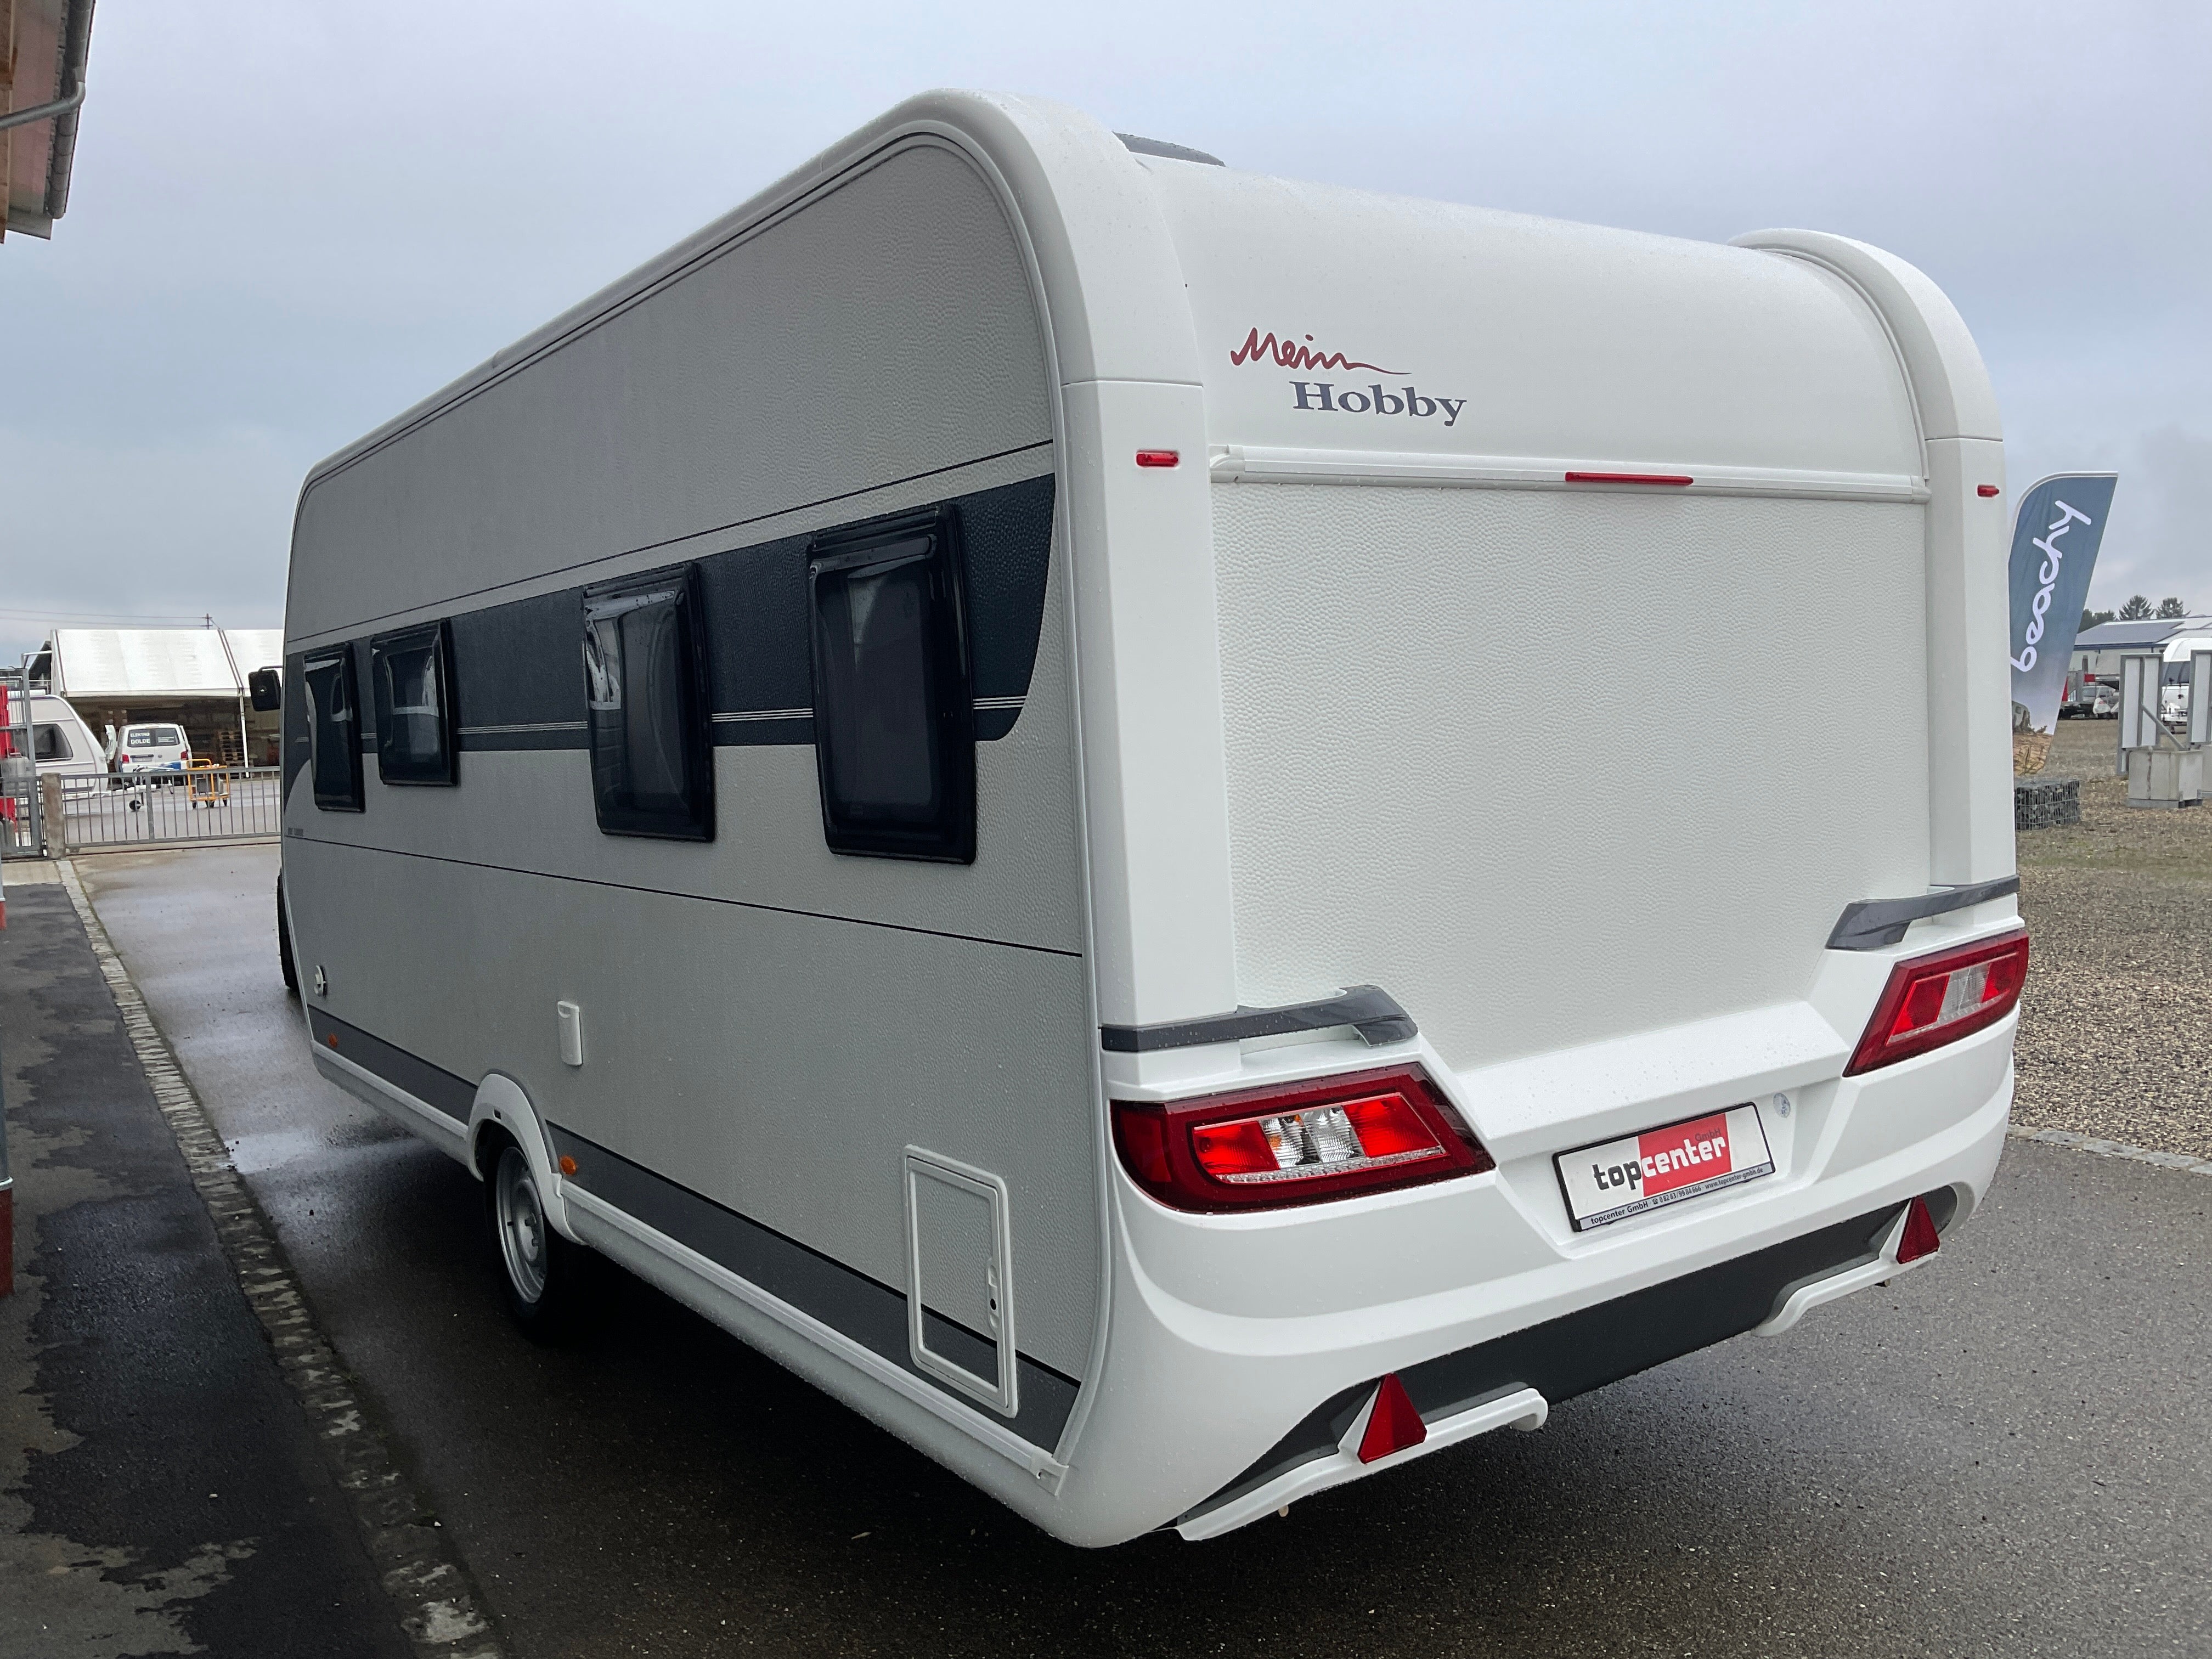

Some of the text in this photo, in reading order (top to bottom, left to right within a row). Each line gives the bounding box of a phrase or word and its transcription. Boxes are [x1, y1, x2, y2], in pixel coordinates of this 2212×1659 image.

[1231, 327, 1412, 375] Mein
[1289, 381, 1467, 427] Hobby
[2010, 500, 2092, 673] beachy
[1695, 1127, 1722, 1141] GmbH
[1592, 1136, 1726, 1190] topcenter
[1591, 1209, 1626, 1224] topcenter
[1627, 1201, 1649, 1213] GmbH
[1704, 1167, 1763, 1190] www.topcenter-gmbh.de
